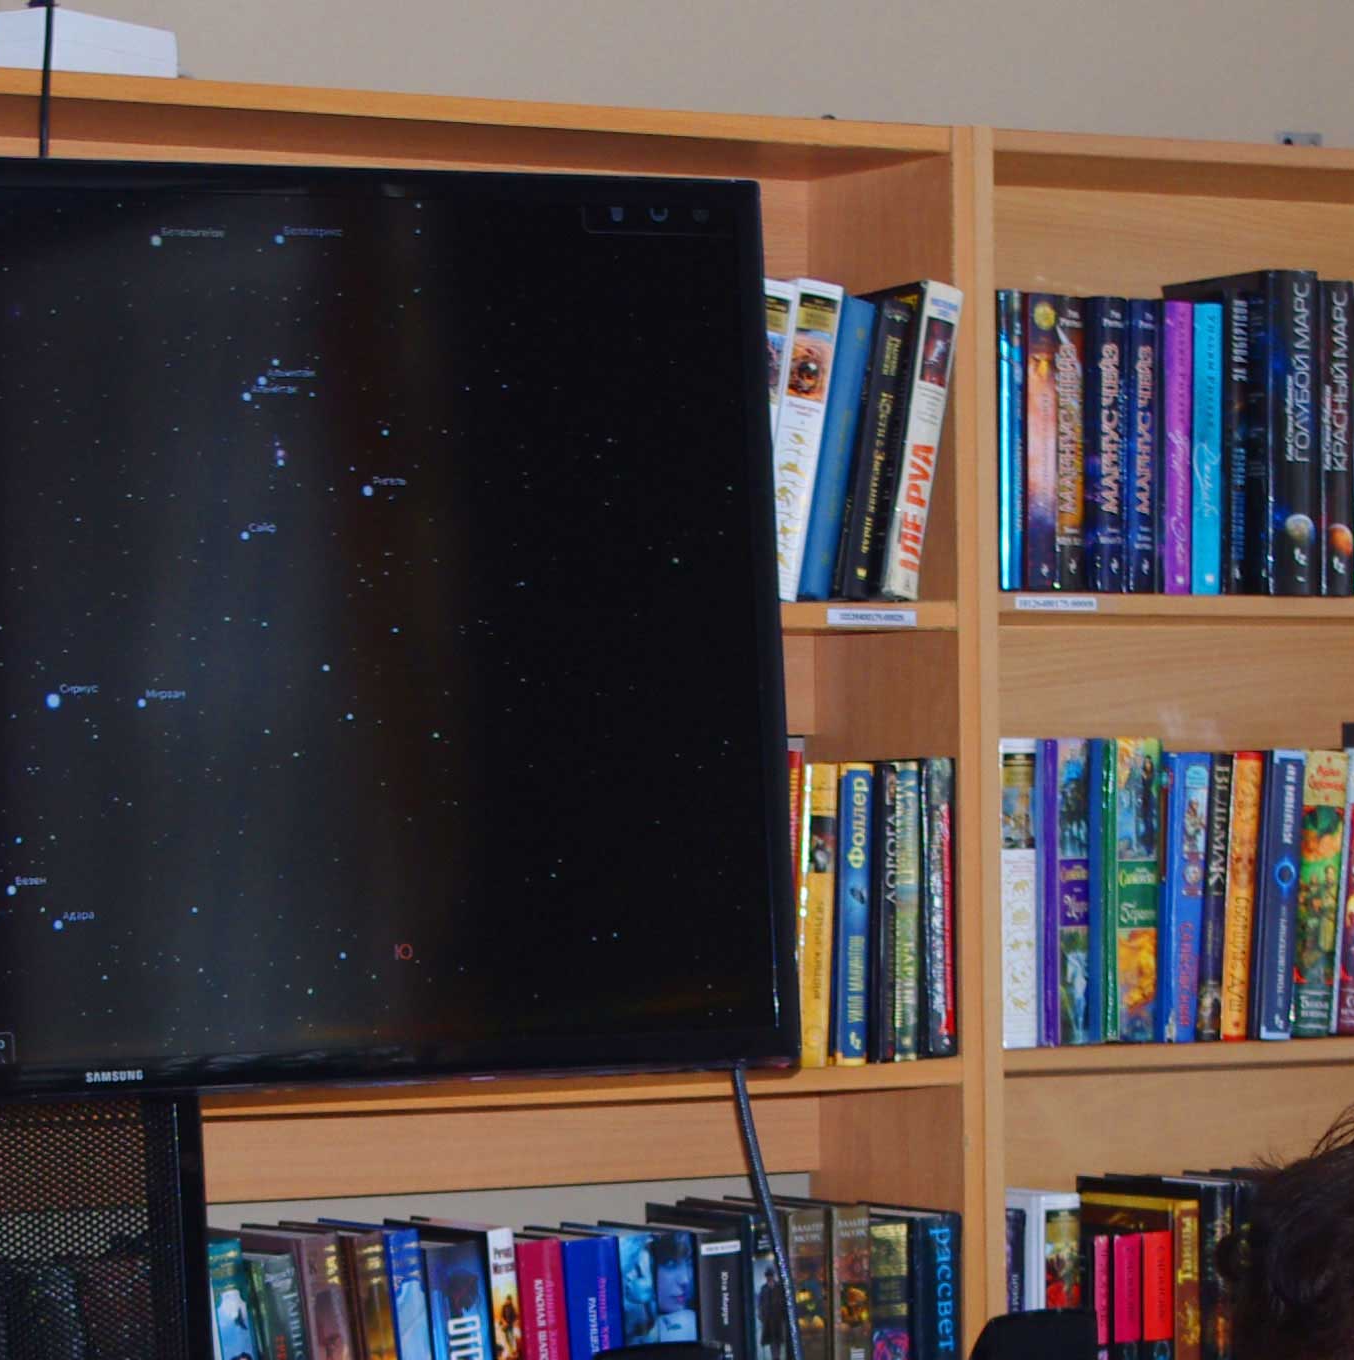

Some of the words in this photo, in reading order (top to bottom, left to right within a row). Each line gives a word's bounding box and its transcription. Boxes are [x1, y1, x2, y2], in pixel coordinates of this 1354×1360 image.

[1293, 282, 1309, 348] МАРС
[1332, 290, 1348, 356] МАРС
[1292, 355, 1309, 460] ГОЛУБОЙ
[1330, 364, 1350, 470] КРАСНЫЙ
[60, 684, 99, 695] Сириус
[85, 1070, 143, 1083] SAMSUNG
[532, 1279, 547, 1327] КРАСНАЯ
[930, 1226, 957, 1351] рассвет
